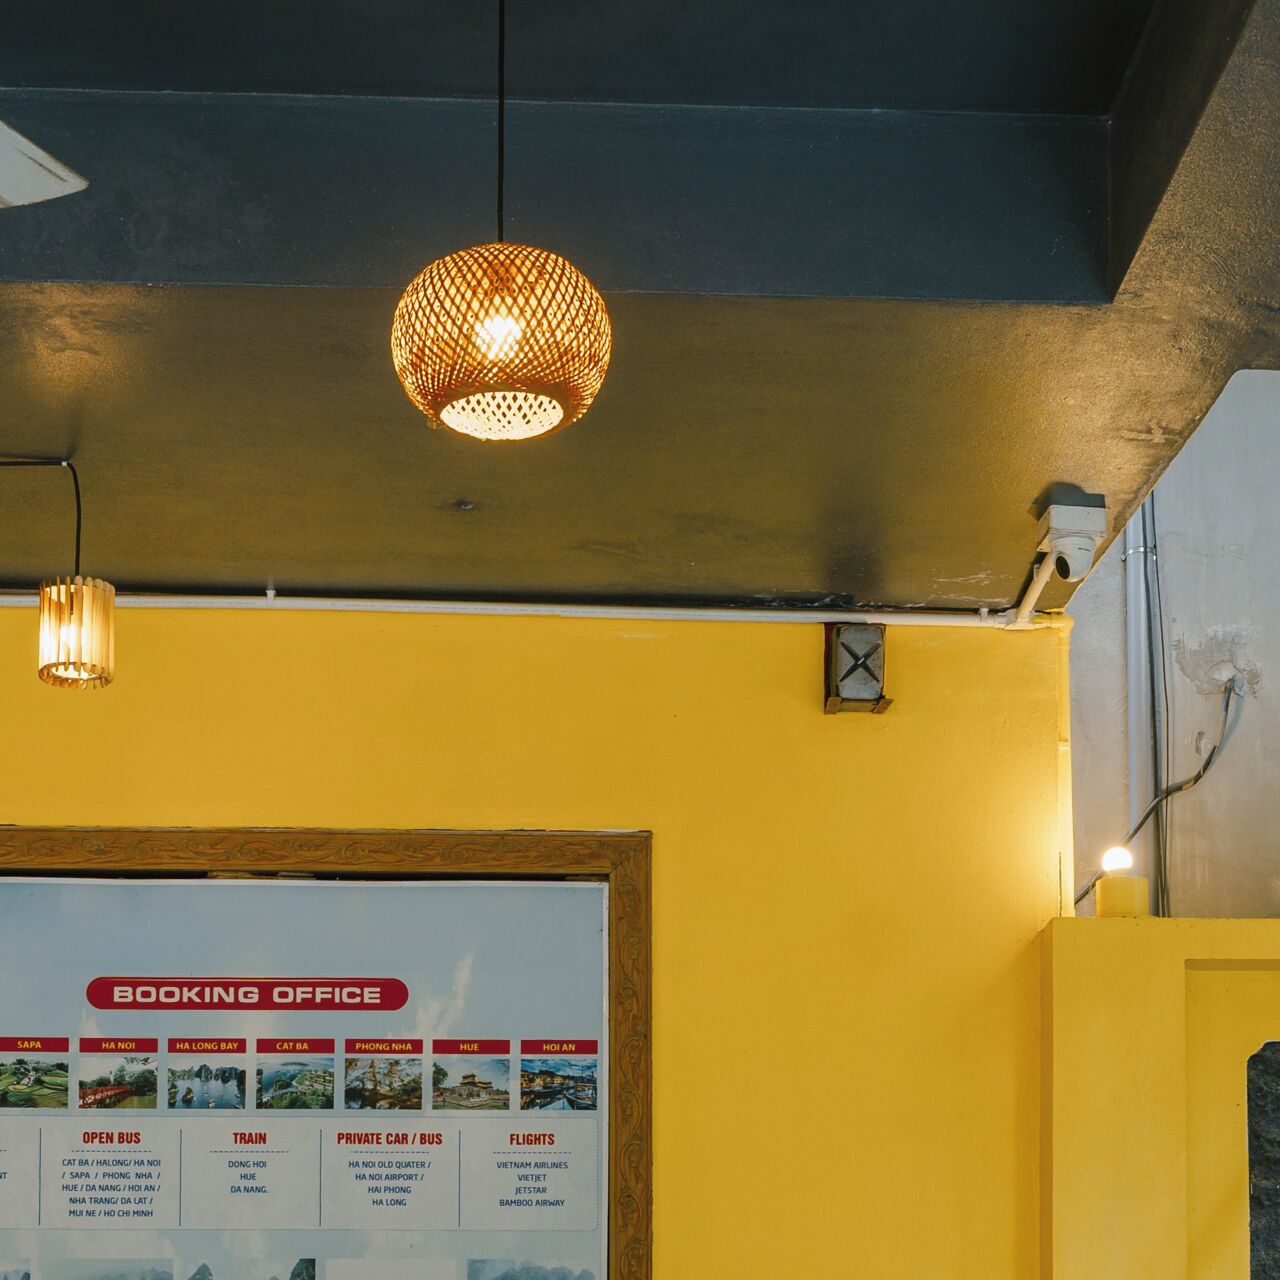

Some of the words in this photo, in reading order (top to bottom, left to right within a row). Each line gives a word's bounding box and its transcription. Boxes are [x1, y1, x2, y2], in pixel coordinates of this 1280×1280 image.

[113, 986, 259, 1003] BOOKING
[272, 987, 381, 1004] OFFICE
[17, 1040, 42, 1049] SAPA
[102, 1041, 116, 1049] HA
[117, 1041, 136, 1050] NOI
[176, 1042, 190, 1050] HA
[192, 1042, 218, 1050] LONG
[220, 1042, 238, 1051] BAY
[276, 1042, 294, 1051] CAT
[295, 1042, 309, 1051] BA
[355, 1042, 390, 1051] PHONG
[391, 1043, 412, 1051] NHA
[459, 1043, 479, 1052] HUE
[543, 1043, 560, 1051] HOI
[561, 1043, 576, 1051] AN
[82, 1131, 114, 1144] OPEN
[117, 1132, 141, 1144] BUS
[232, 1132, 267, 1145] TRAIN
[337, 1132, 382, 1145] PRIVATE
[386, 1132, 409, 1145] CAR
[411, 1133, 417, 1145] /
[419, 1133, 443, 1145] BUS
[510, 1133, 555, 1146] FLIGHTS
[62, 1158, 77, 1166] CAT
[78, 1159, 90, 1167] BA
[133, 1159, 145, 1167] HA
[146, 1159, 161, 1167] NOI
[228, 1160, 251, 1168] DONG
[252, 1160, 267, 1168] HOI
[361, 1160, 376, 1169] NOI
[377, 1161, 394, 1169] OLD
[395, 1161, 426, 1170] QUATER
[496, 1161, 532, 1169] VIETNAM
[533, 1161, 568, 1169] AIRLINES
[69, 1171, 90, 1179] SAPA
[102, 1172, 131, 1180] PHONG
[135, 1172, 153, 1180] NHA
[240, 1173, 257, 1181] HUE
[355, 1173, 367, 1181] HA
[368, 1173, 383, 1181] NOI
[384, 1173, 419, 1181] AIRPORT
[517, 1174, 547, 1183] VIETJET
[62, 1184, 78, 1192] HUE
[85, 1184, 97, 1192] DA
[98, 1184, 121, 1192] NANG
[128, 1184, 142, 1192] HOI
[143, 1184, 156, 1192] AN
[230, 1185, 242, 1193] DA
[368, 1186, 382, 1194] HAI
[383, 1186, 412, 1194] PHONG
[514, 1186, 547, 1196] JETSTAR
[120, 1197, 132, 1205] DA
[133, 1197, 148, 1205] LAT
[372, 1198, 384, 1206] HA
[385, 1198, 407, 1206] LONG
[499, 1199, 533, 1207] BAMBOO
[535, 1199, 565, 1207] AIRWAY
[68, 1209, 84, 1217] MUI
[85, 1209, 96, 1217] NE
[103, 1209, 116, 1217] HO
[117, 1209, 131, 1217] CHI
